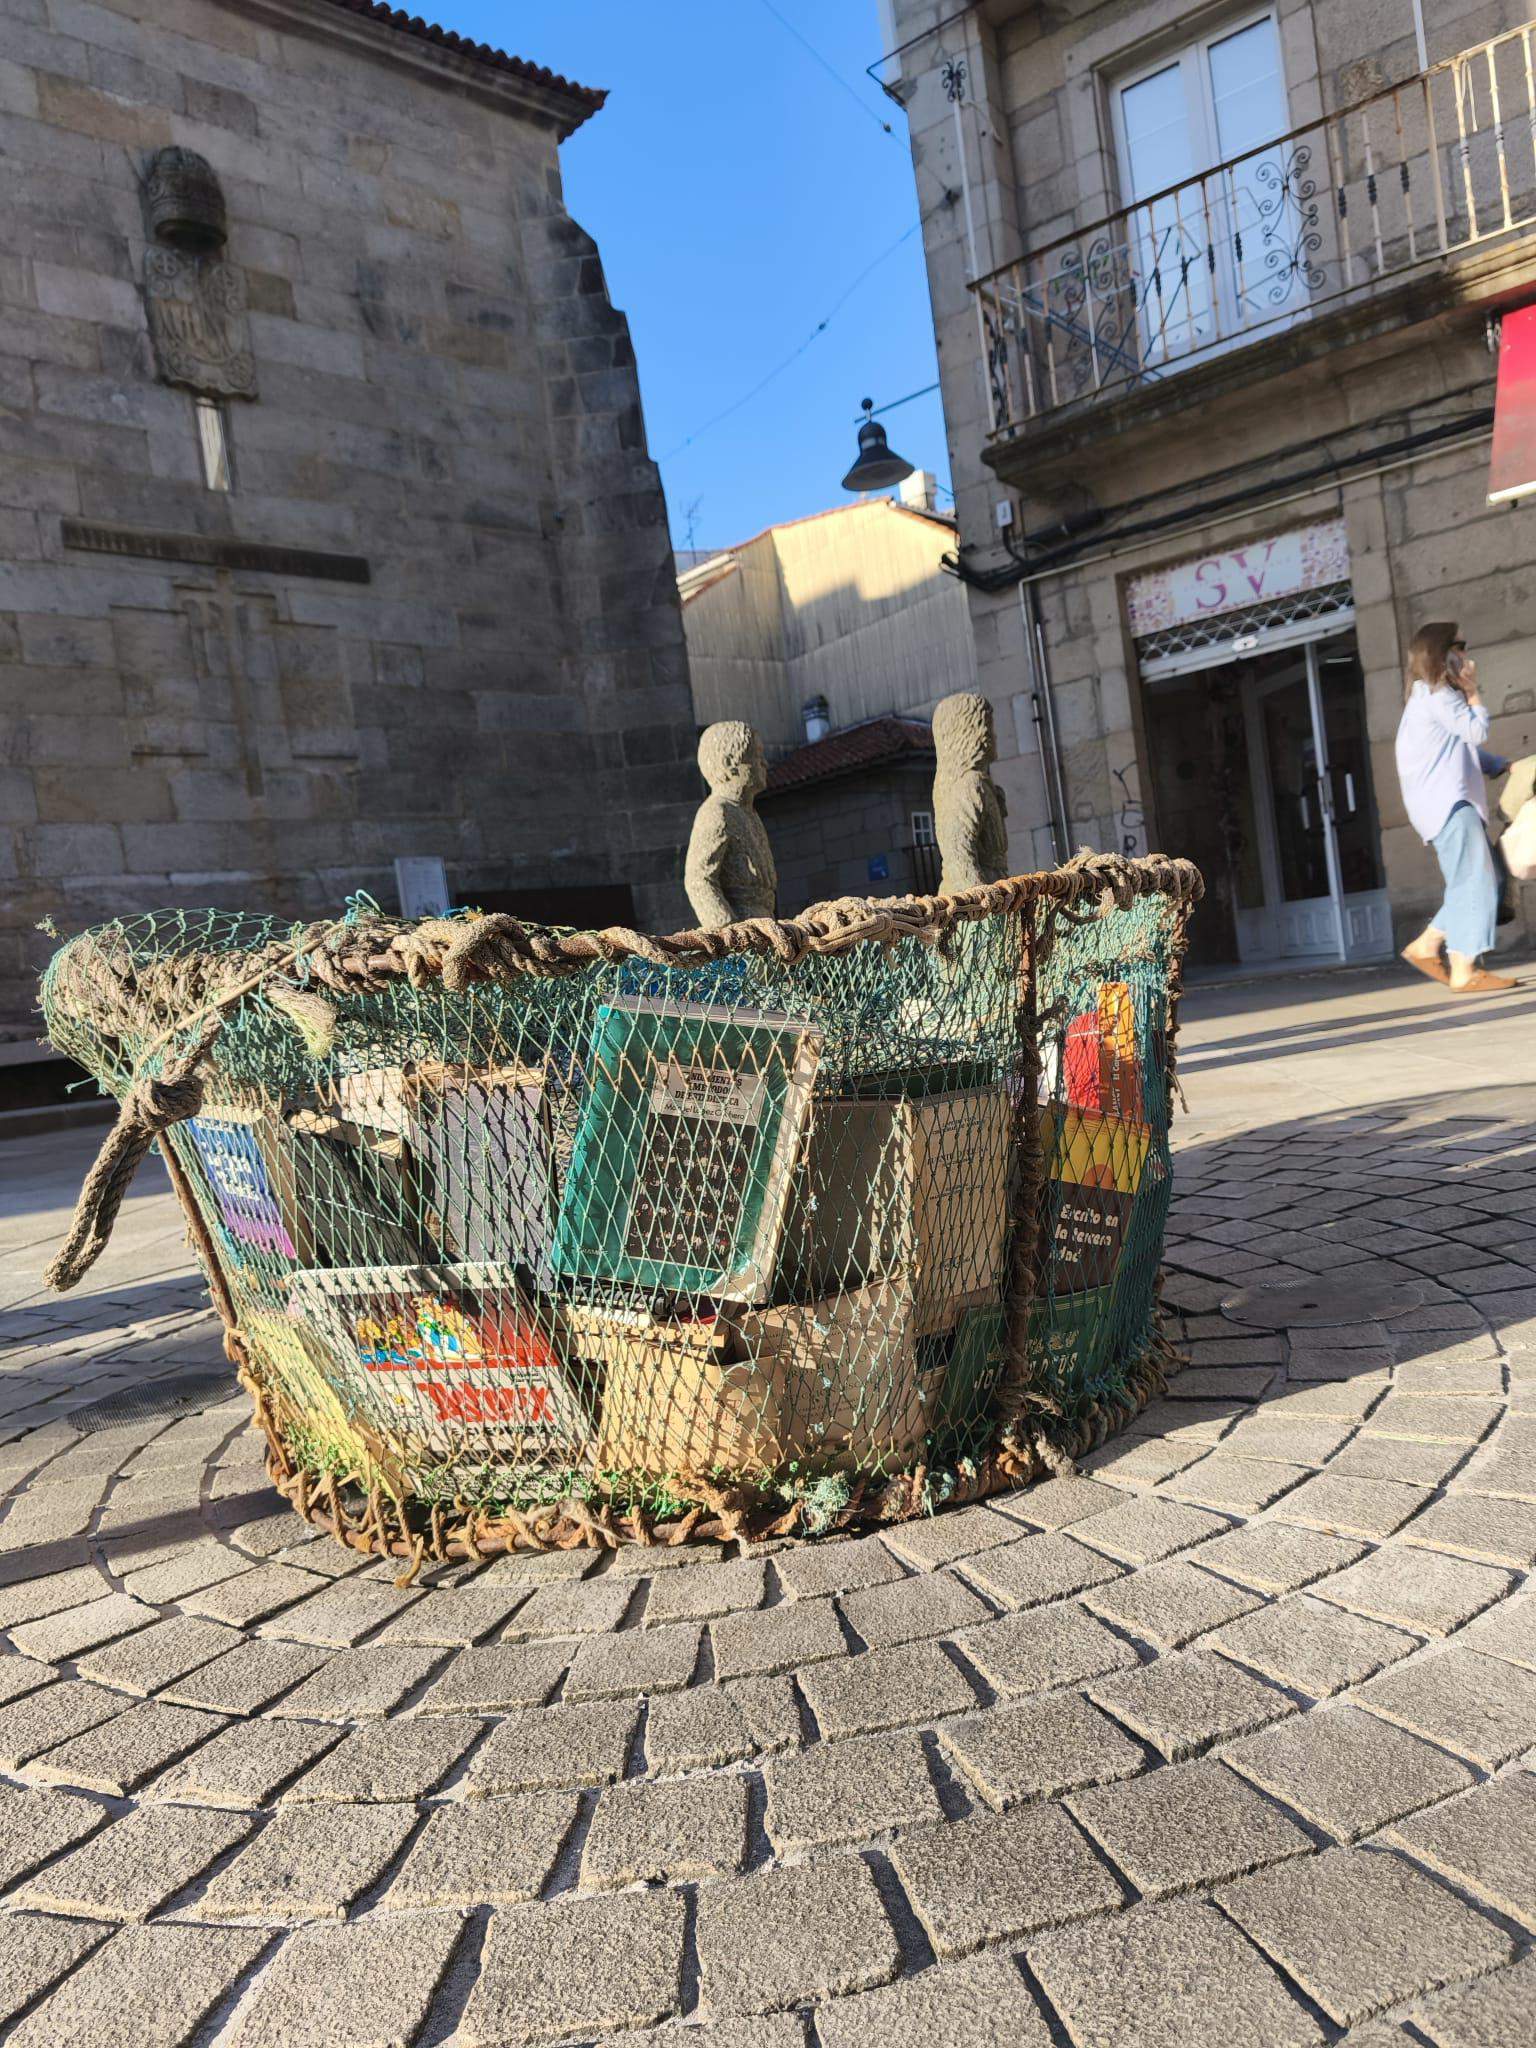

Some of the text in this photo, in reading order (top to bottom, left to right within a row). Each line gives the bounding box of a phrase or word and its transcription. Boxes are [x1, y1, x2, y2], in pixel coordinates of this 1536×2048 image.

[682, 1071, 743, 1087] NDMENTS
[692, 1082, 734, 1095] MEODOS
[687, 1092, 739, 1106] ESTDISTCA
[664, 1103, 693, 1113] Mauel
[714, 1108, 745, 1120] Chero
[1105, 1214, 1119, 1228] en
[1054, 1223, 1068, 1240] la
